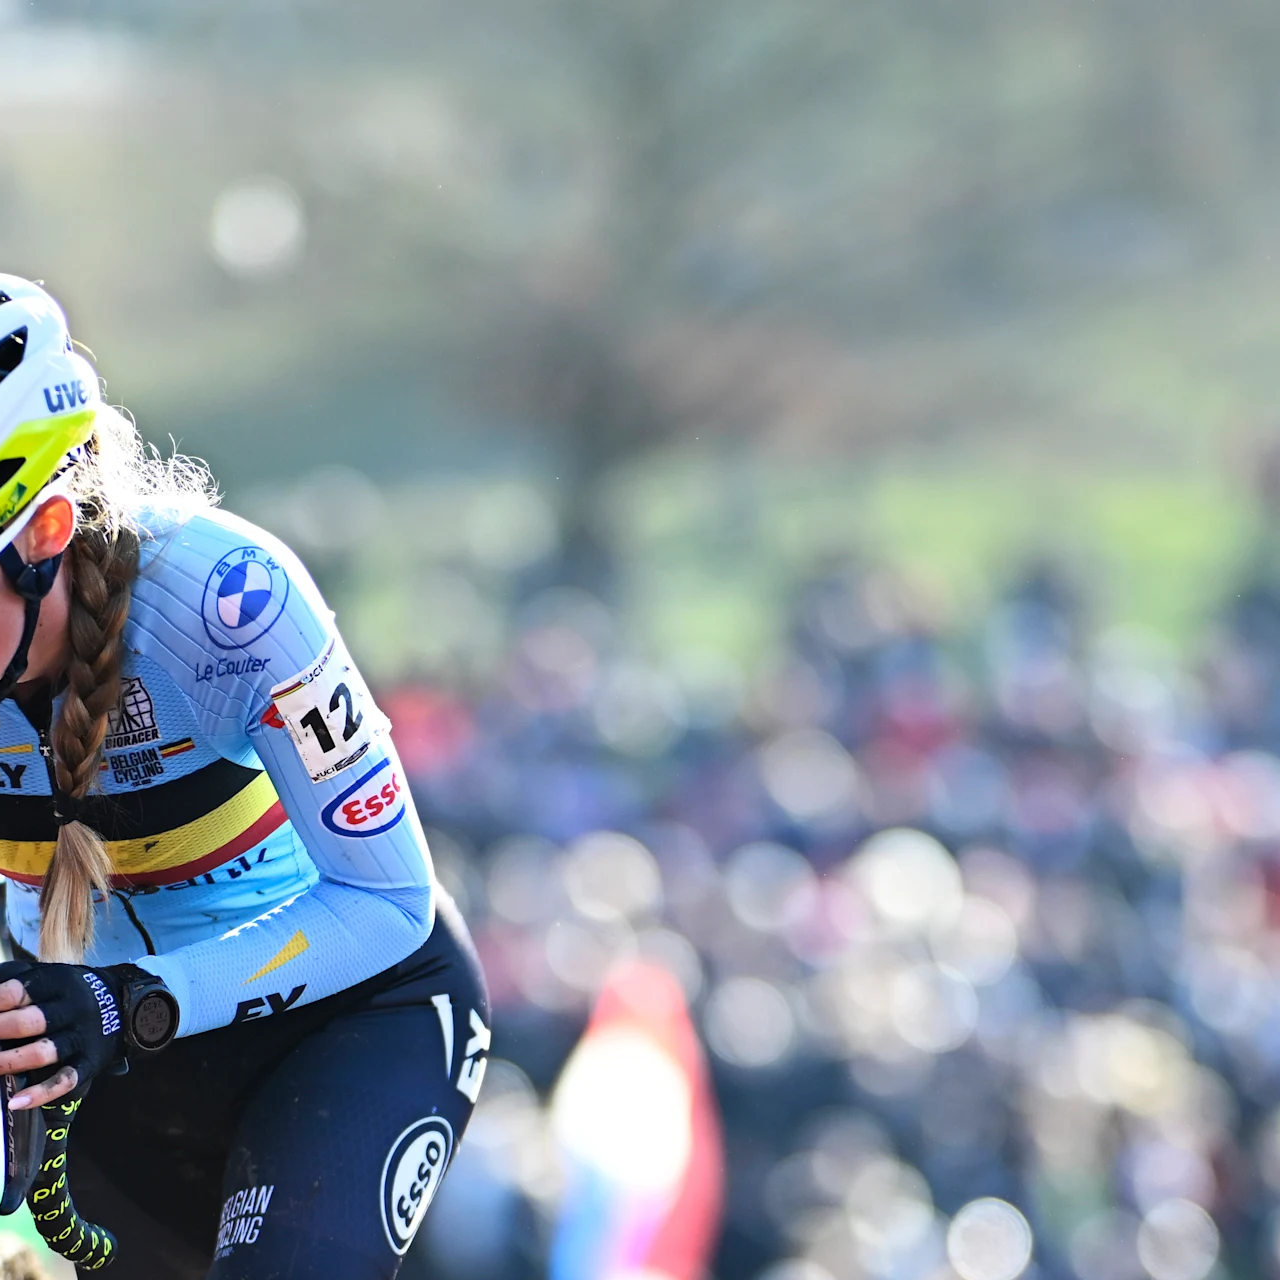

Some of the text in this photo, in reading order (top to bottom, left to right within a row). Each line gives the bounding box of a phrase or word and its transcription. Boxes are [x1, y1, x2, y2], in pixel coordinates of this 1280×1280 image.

[43, 379, 93, 413] uve
[196, 657, 271, 682] Le Couter
[300, 682, 363, 754] 12
[105, 728, 160, 750] BIORACER
[110, 748, 159, 770] BELGIAN
[114, 761, 164, 784] CYCLING
[455, 1008, 492, 1104] EY
[4, 1074, 16, 1178] DUA-ACE
[397, 1140, 440, 1228] Esso
